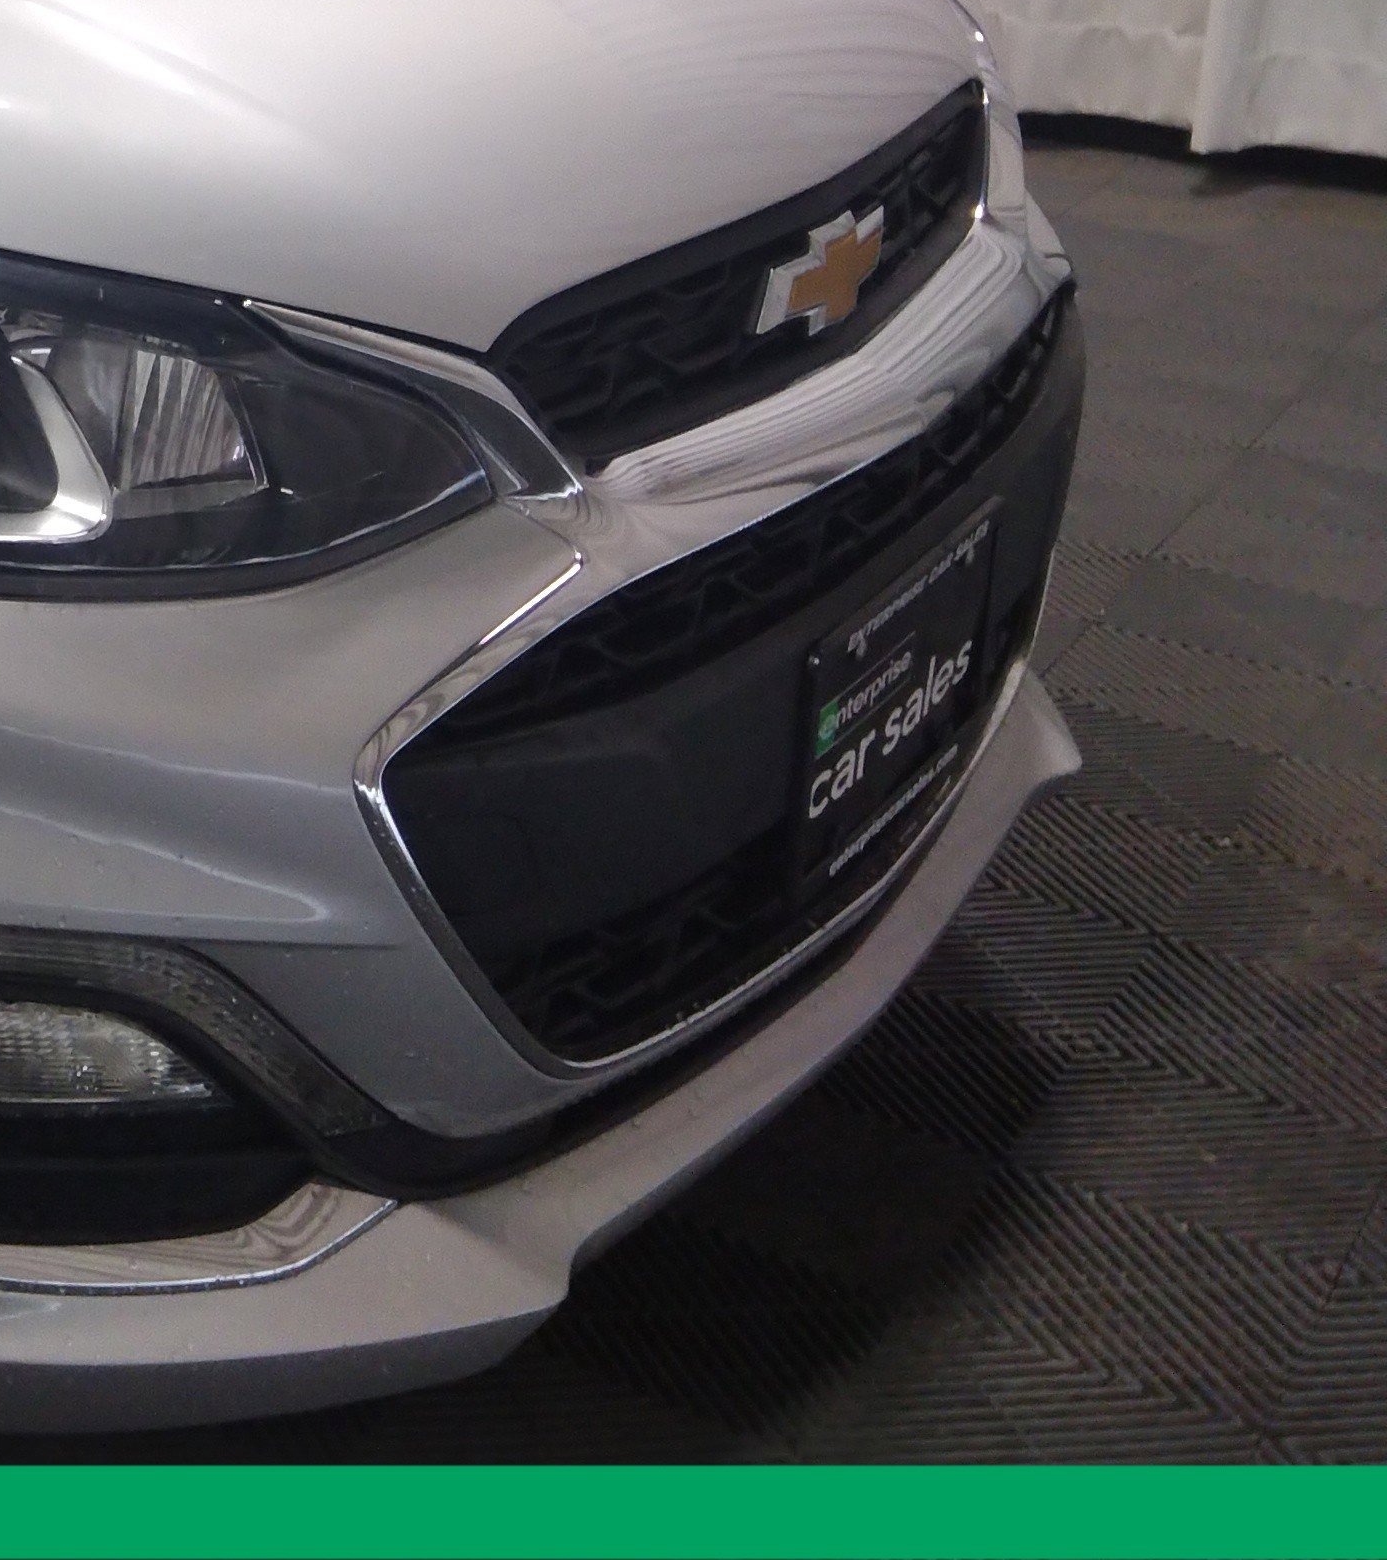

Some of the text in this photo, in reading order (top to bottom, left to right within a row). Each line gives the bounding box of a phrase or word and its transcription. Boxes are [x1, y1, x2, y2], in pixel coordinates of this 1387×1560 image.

[808, 728, 876, 819] car
[882, 639, 973, 757] sales
[817, 650, 912, 740] enterprise
